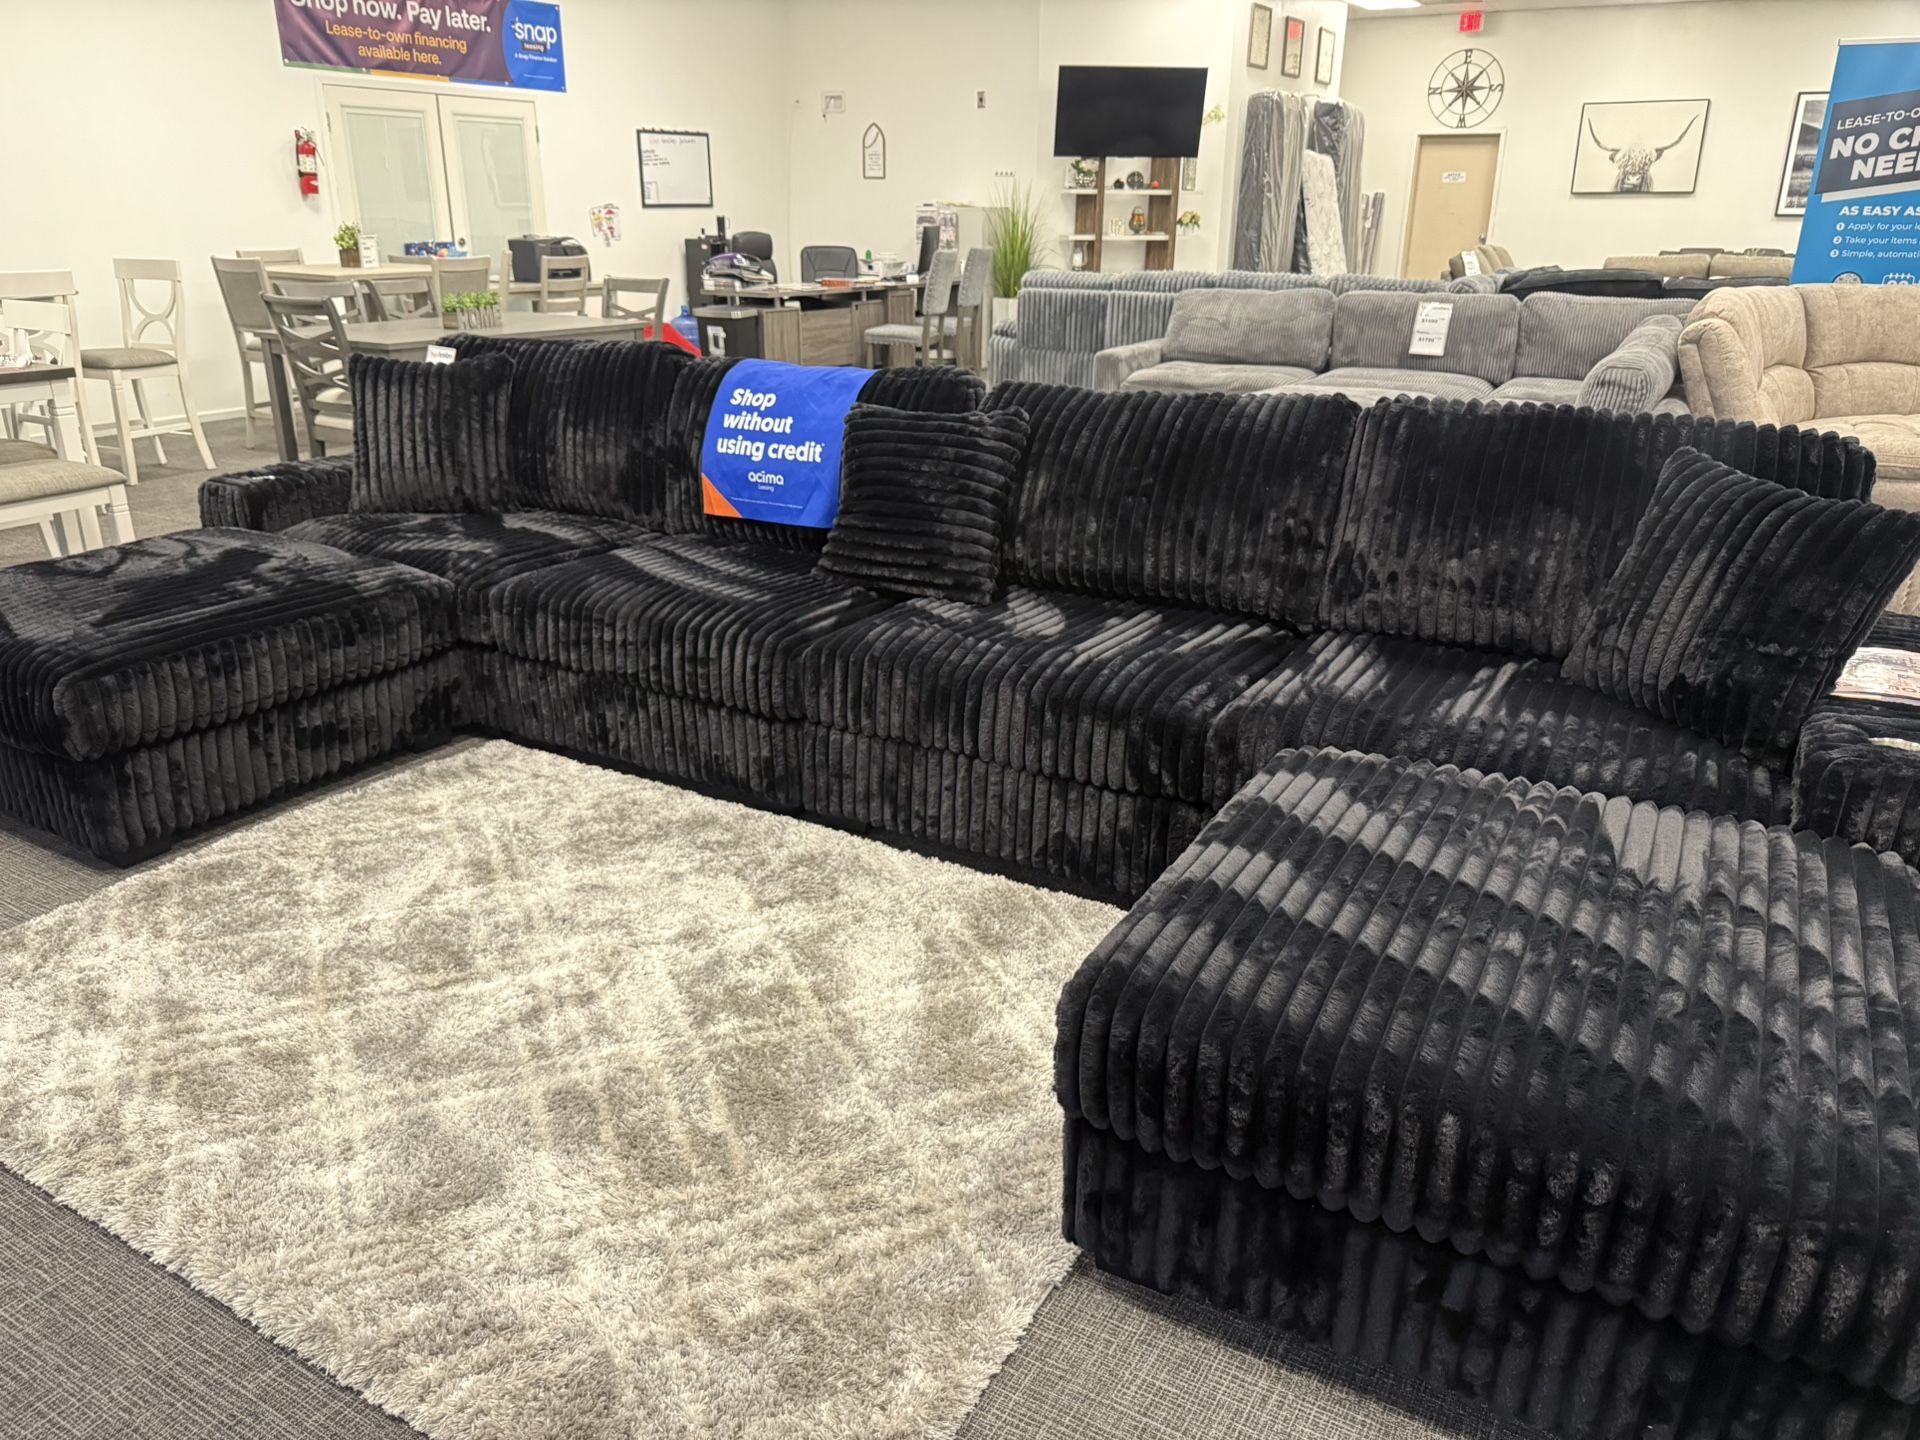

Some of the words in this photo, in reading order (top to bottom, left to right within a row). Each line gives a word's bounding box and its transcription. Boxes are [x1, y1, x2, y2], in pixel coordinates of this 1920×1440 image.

[290, 0, 348, 18] op
[352, 0, 402, 20] now.
[406, 0, 442, 31] Pay
[445, 5, 491, 33] later.
[325, 20, 413, 44] Lease-to-own
[414, 31, 468, 54] financing
[513, 18, 558, 50] snap
[358, 44, 411, 62] available
[412, 48, 442, 65] here.
[1829, 132, 1880, 160] NO
[1838, 205, 1860, 216] AS
[1862, 205, 1902, 216] EASY
[1847, 222, 1875, 232] Apply
[1876, 222, 1889, 231] for
[1890, 224, 1913, 232] your
[1845, 236, 1866, 245] Take
[1867, 237, 1890, 246] your
[1890, 236, 1917, 245] items
[1841, 249, 1875, 259] Simple,
[730, 388, 777, 411] Shop
[723, 411, 794, 434] without
[716, 435, 765, 462] using
[747, 470, 784, 485] acima
